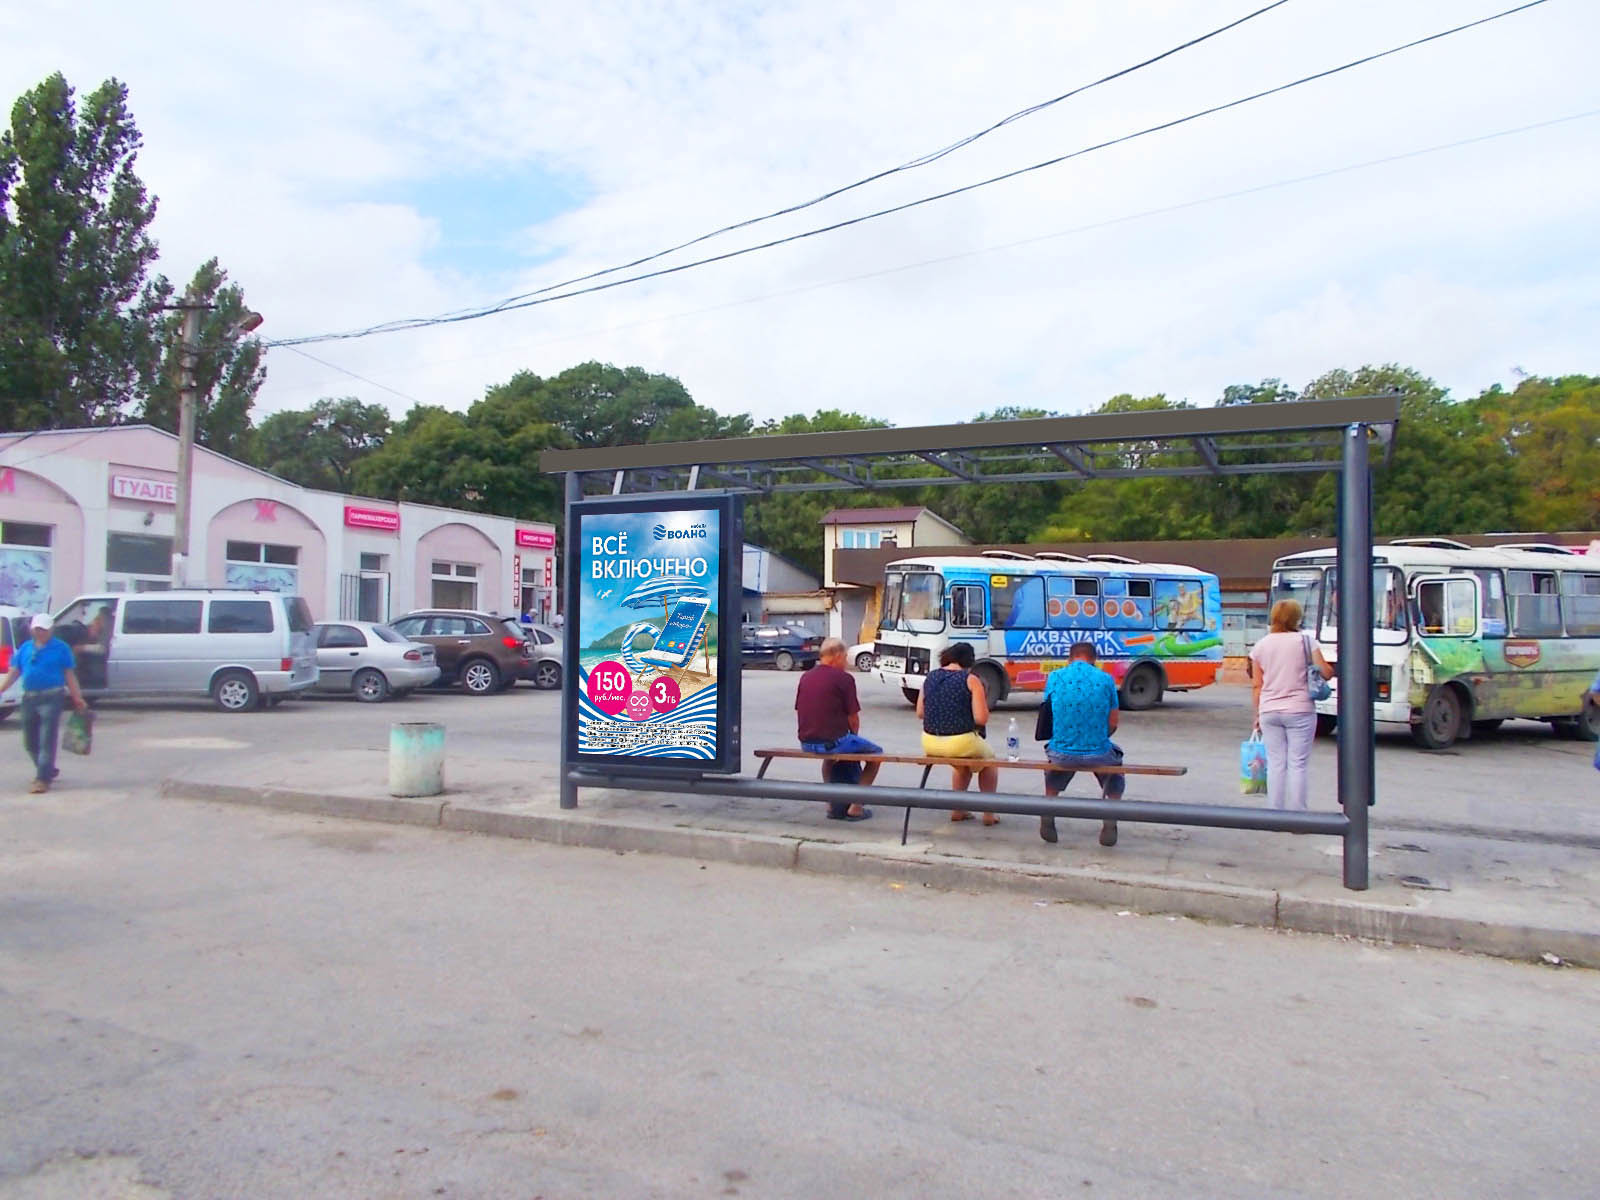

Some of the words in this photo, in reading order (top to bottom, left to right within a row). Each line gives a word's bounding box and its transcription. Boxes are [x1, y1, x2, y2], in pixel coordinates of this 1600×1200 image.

[118, 479, 175, 499] ТУАЛЕ
[592, 531, 628, 556] ВСЁ
[592, 557, 708, 579] ВКЛЮЧЕНО
[1022, 630, 1119, 645] АКВАПАРК
[1026, 643, 1115, 656] КОКТЕЛЬ
[594, 671, 626, 691] 150
[594, 692, 626, 703] руб./мес.
